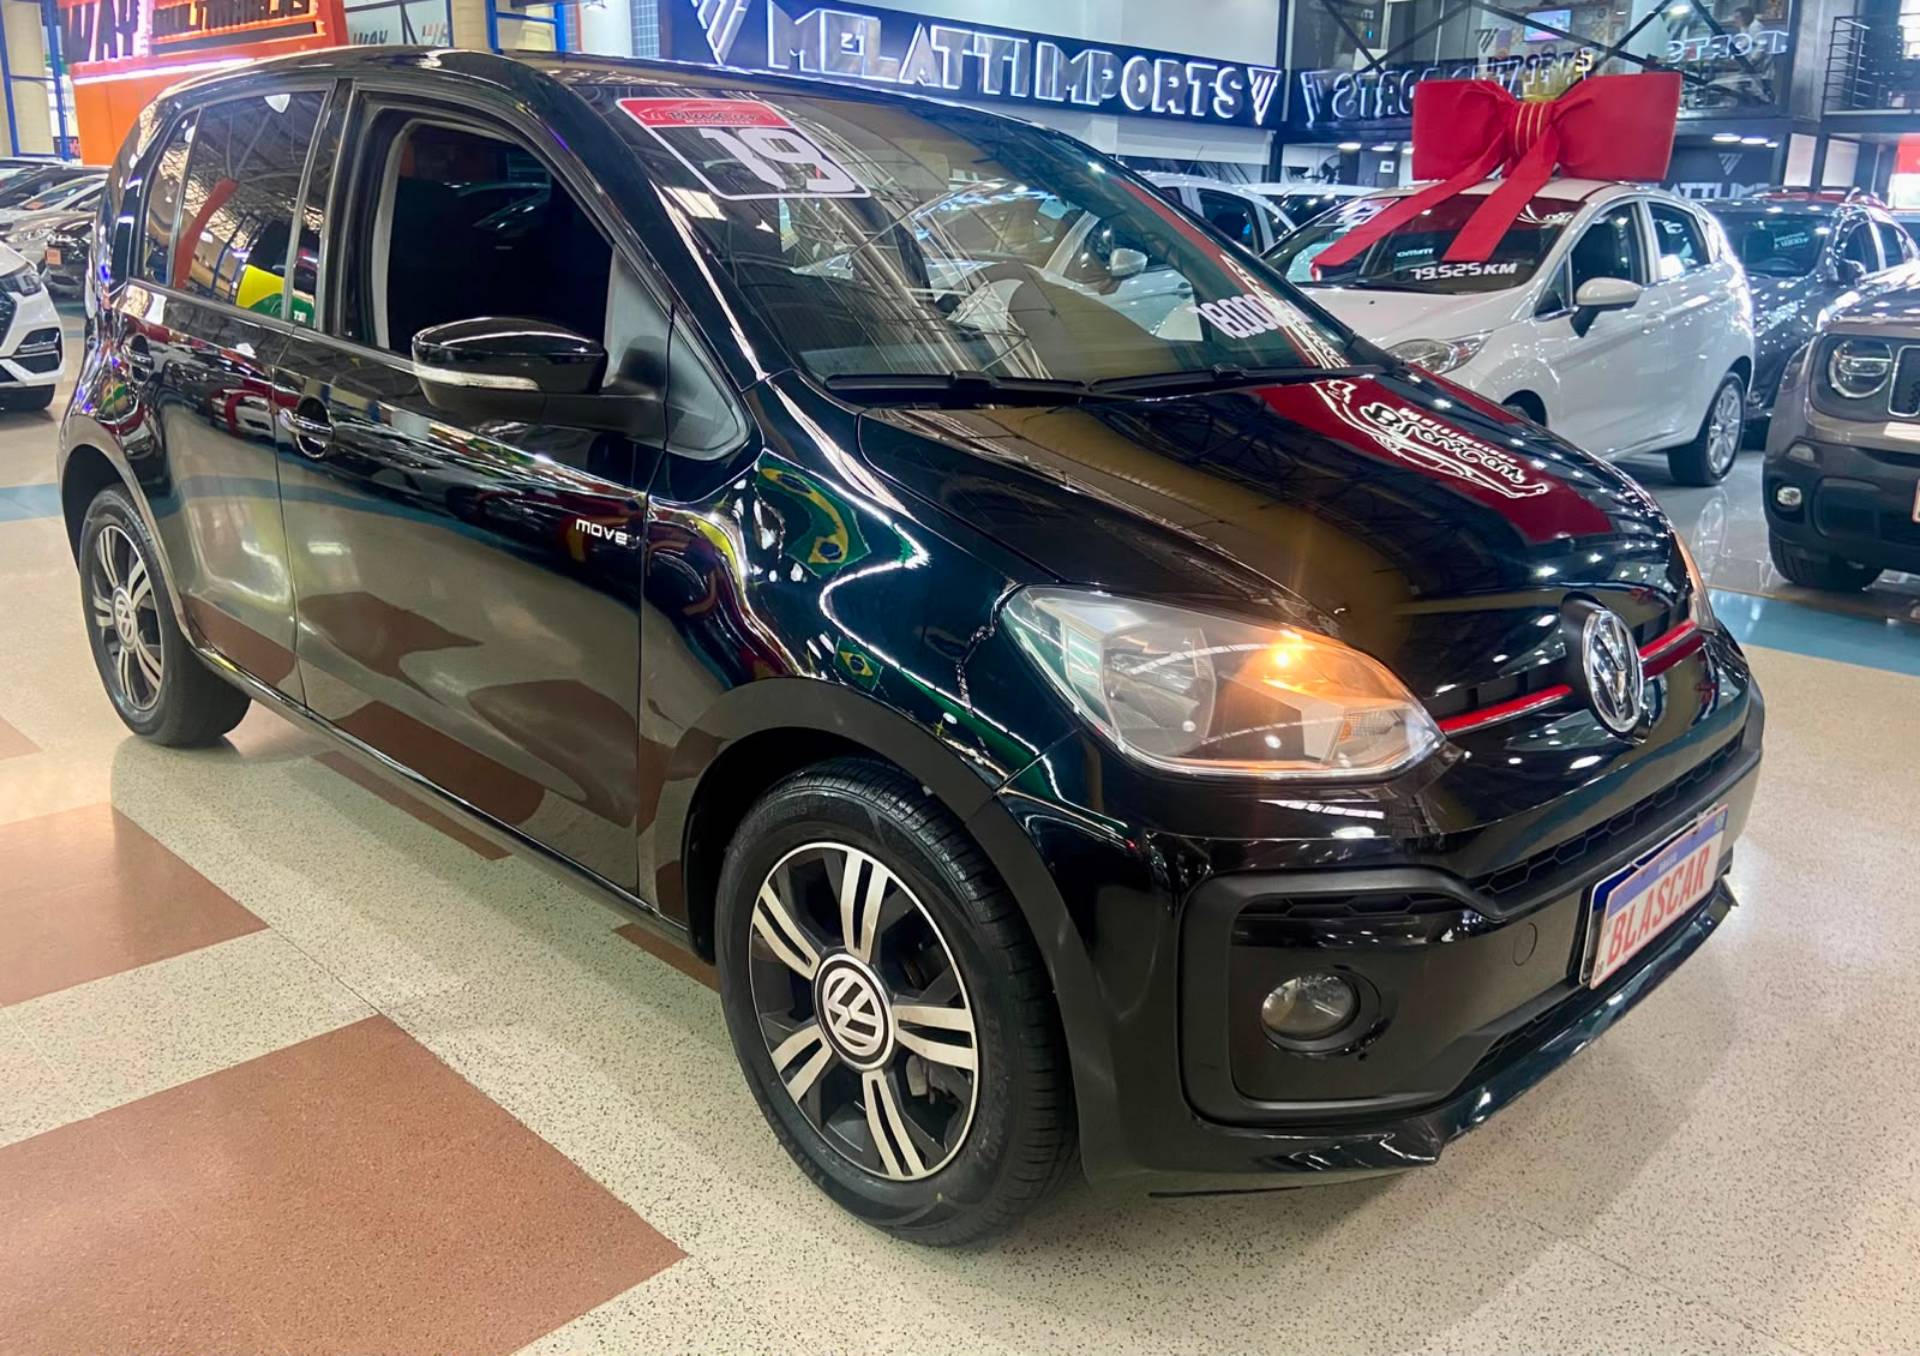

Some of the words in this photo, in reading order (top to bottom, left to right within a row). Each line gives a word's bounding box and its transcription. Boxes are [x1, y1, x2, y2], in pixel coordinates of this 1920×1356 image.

[1034, 41, 1243, 118] IMPORTS
[698, 127, 856, 192] 19
[1606, 845, 1711, 966] BLASCAR
